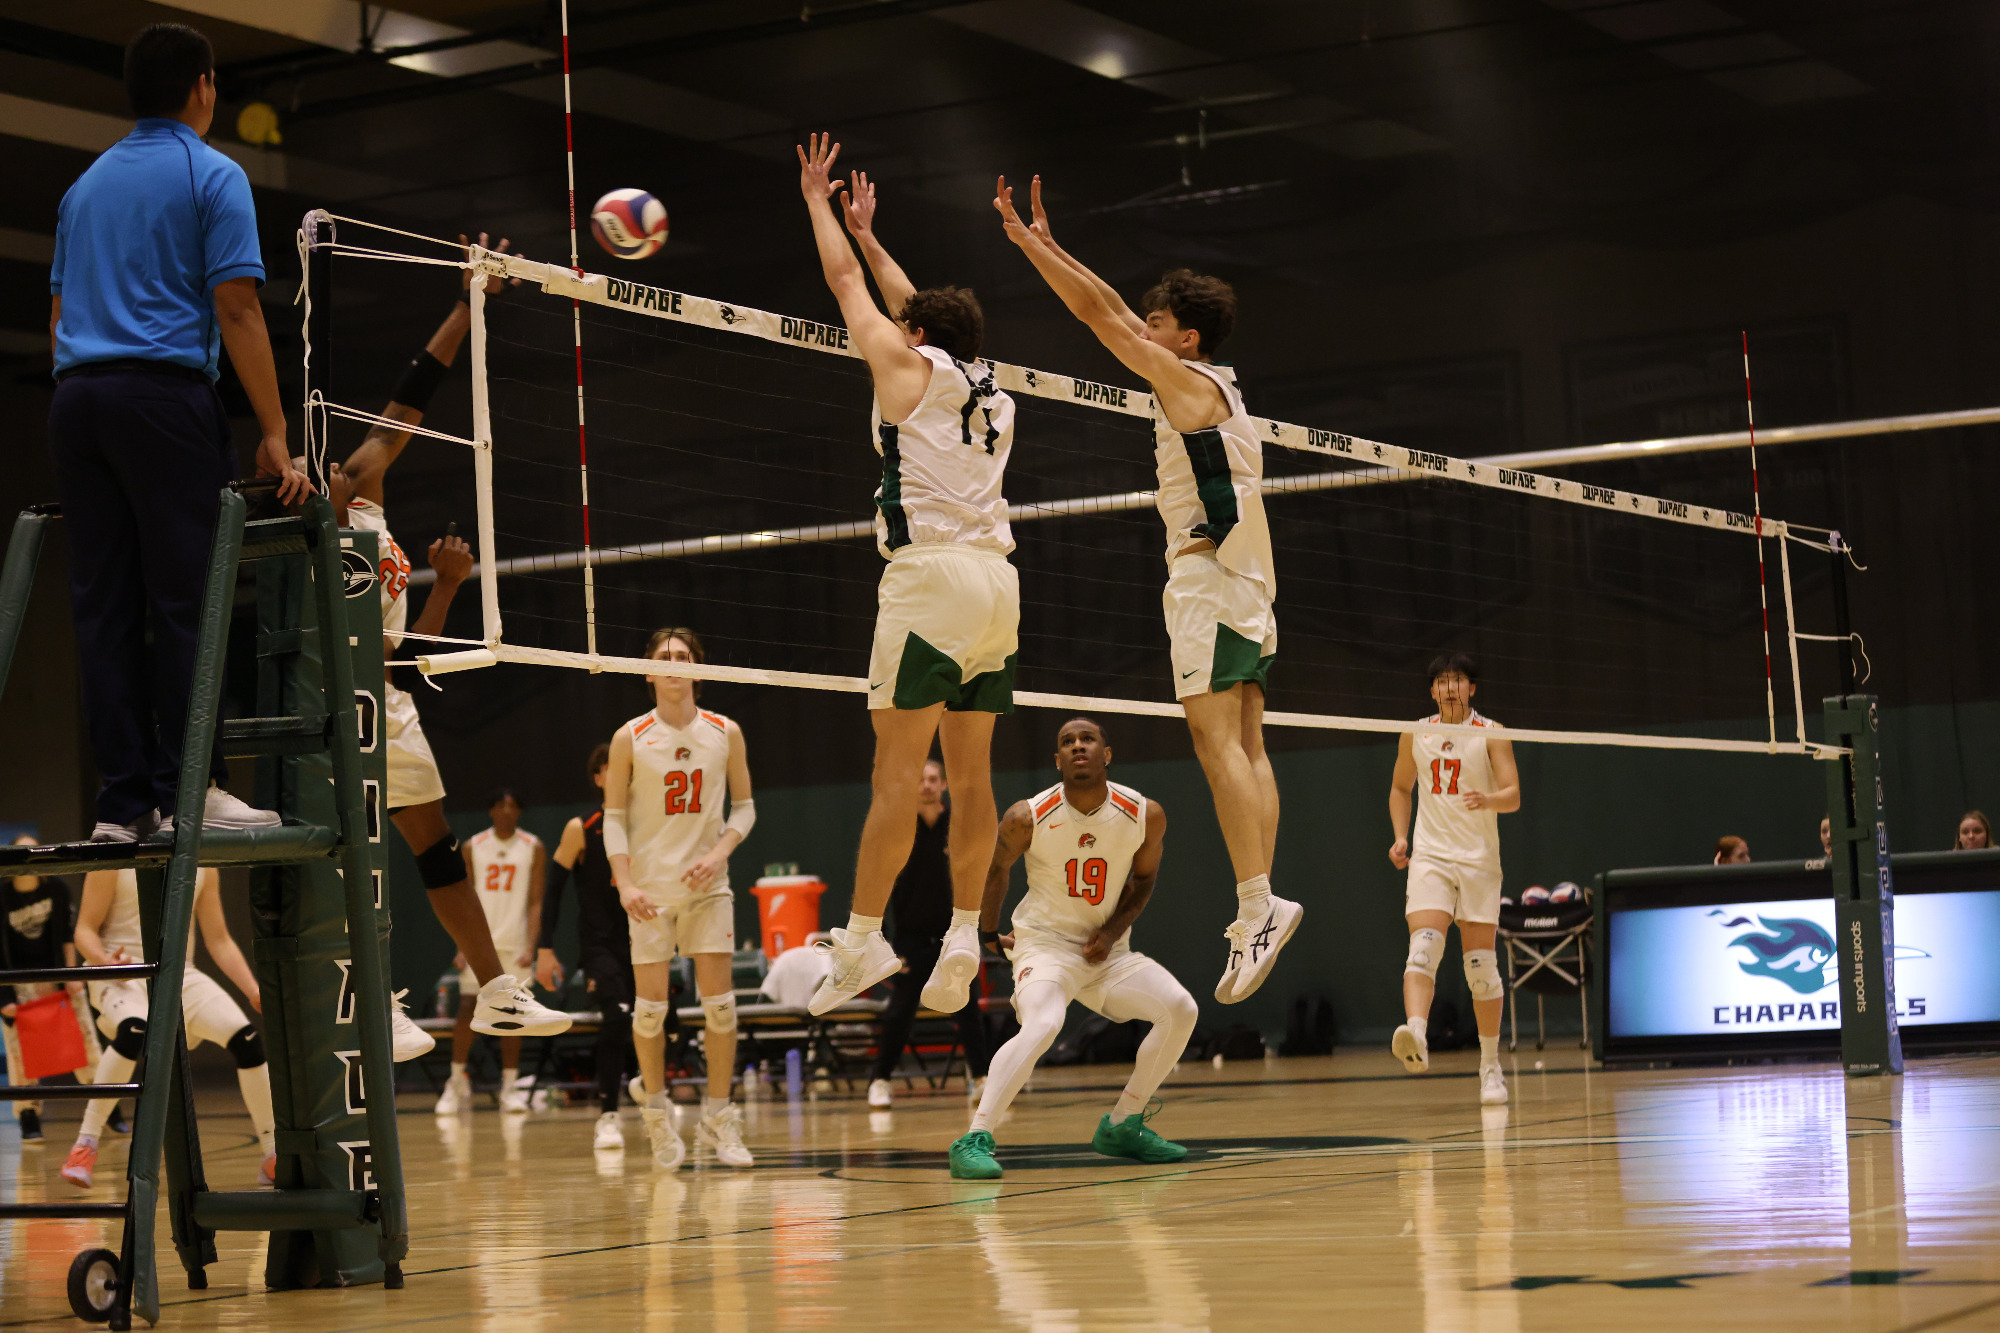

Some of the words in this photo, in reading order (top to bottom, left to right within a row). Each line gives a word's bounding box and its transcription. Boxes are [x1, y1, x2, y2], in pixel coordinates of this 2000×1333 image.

[607, 278, 682, 315] DUPAGE
[781, 317, 849, 350] DUPAGE
[1073, 379, 1127, 408] DUPAGE
[961, 391, 999, 456] 11
[1308, 428, 1352, 453] DUPAGE
[1408, 450, 1448, 472] DUPAGE
[1498, 468, 1536, 489] DUPAGE
[1582, 484, 1615, 505] DUPAGE
[1658, 500, 1688, 518] DUPAGE
[1431, 758, 1461, 794] 17
[664, 769, 702, 815] 21
[486, 864, 516, 891] 27
[1065, 858, 1107, 906] 19
[1524, 916, 1559, 929] molten
[1851, 920, 1864, 962] sports
[1854, 963, 1867, 1013] imports
[1714, 997, 1926, 1025] CHAPARS
